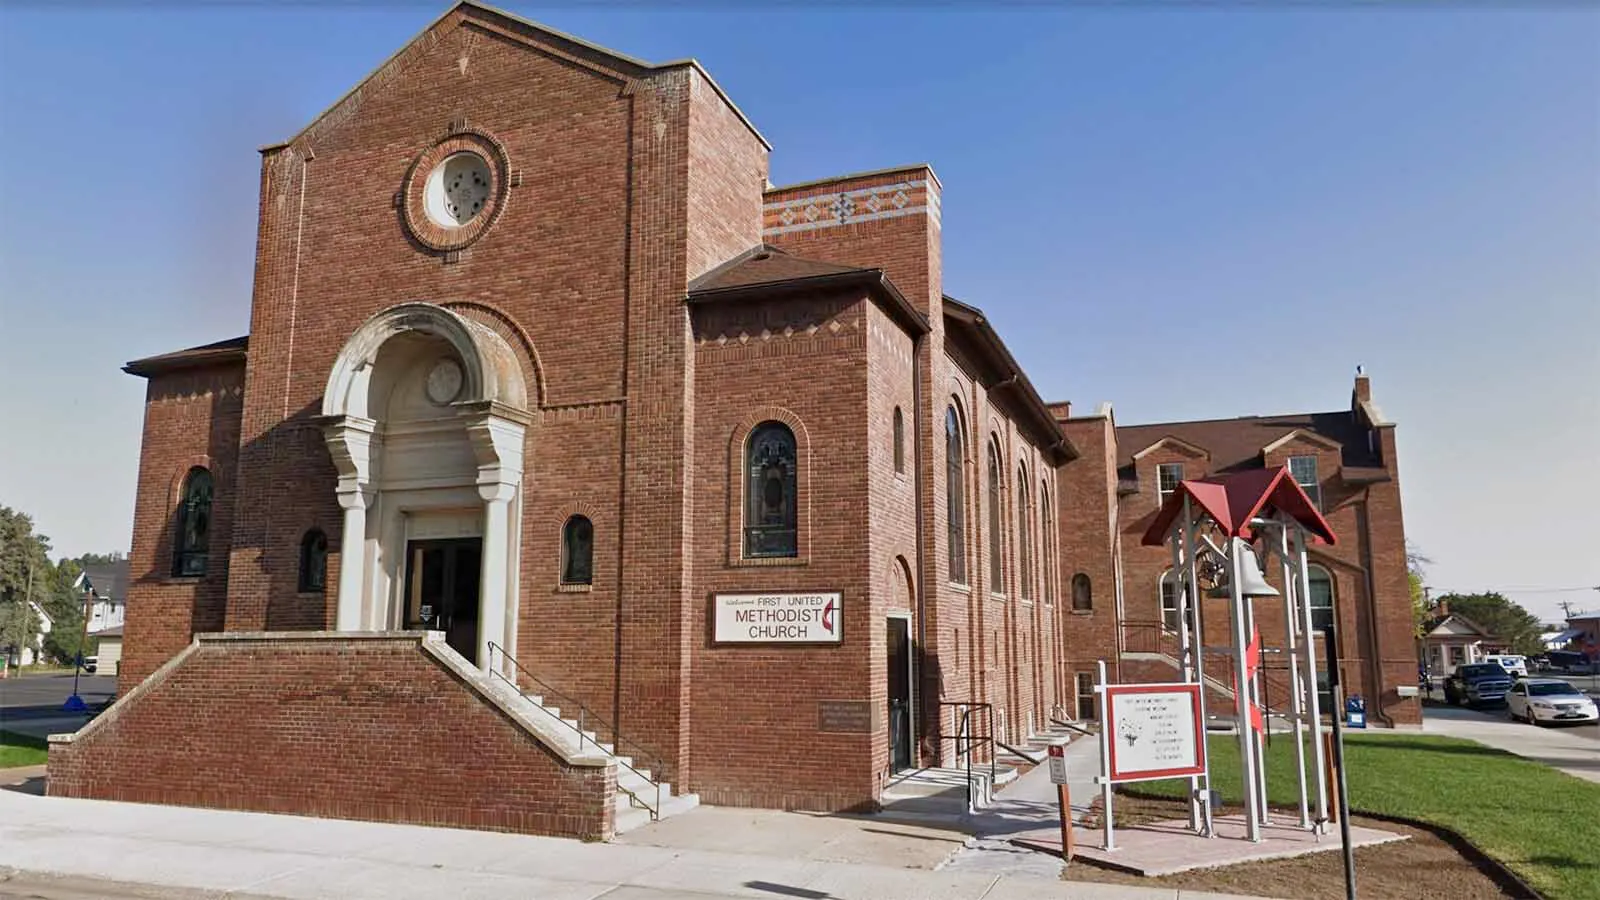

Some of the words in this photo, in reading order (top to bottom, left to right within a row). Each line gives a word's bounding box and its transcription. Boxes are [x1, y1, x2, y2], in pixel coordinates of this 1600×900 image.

[757, 597, 781, 607] FIRST
[788, 596, 823, 606] UNITED
[735, 609, 822, 623] METHODIST
[748, 625, 808, 639] CHURCH
